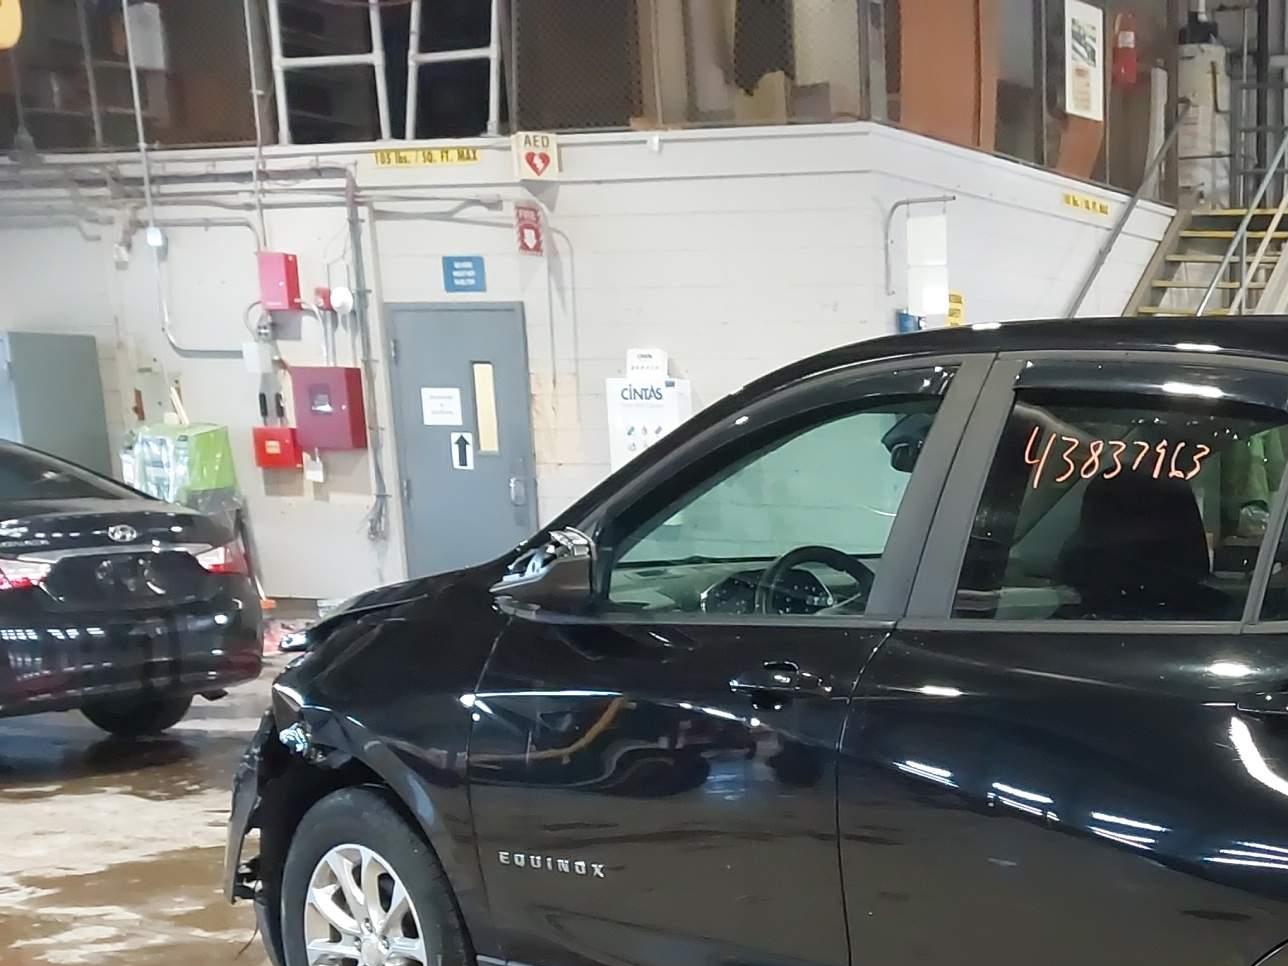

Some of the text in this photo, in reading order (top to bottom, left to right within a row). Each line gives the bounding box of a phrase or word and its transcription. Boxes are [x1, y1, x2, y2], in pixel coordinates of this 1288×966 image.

[523, 134, 550, 148] AED
[457, 148, 478, 162] MAX
[1024, 425, 1211, 489] 43837963
[498, 851, 605, 878] EQUINOX
